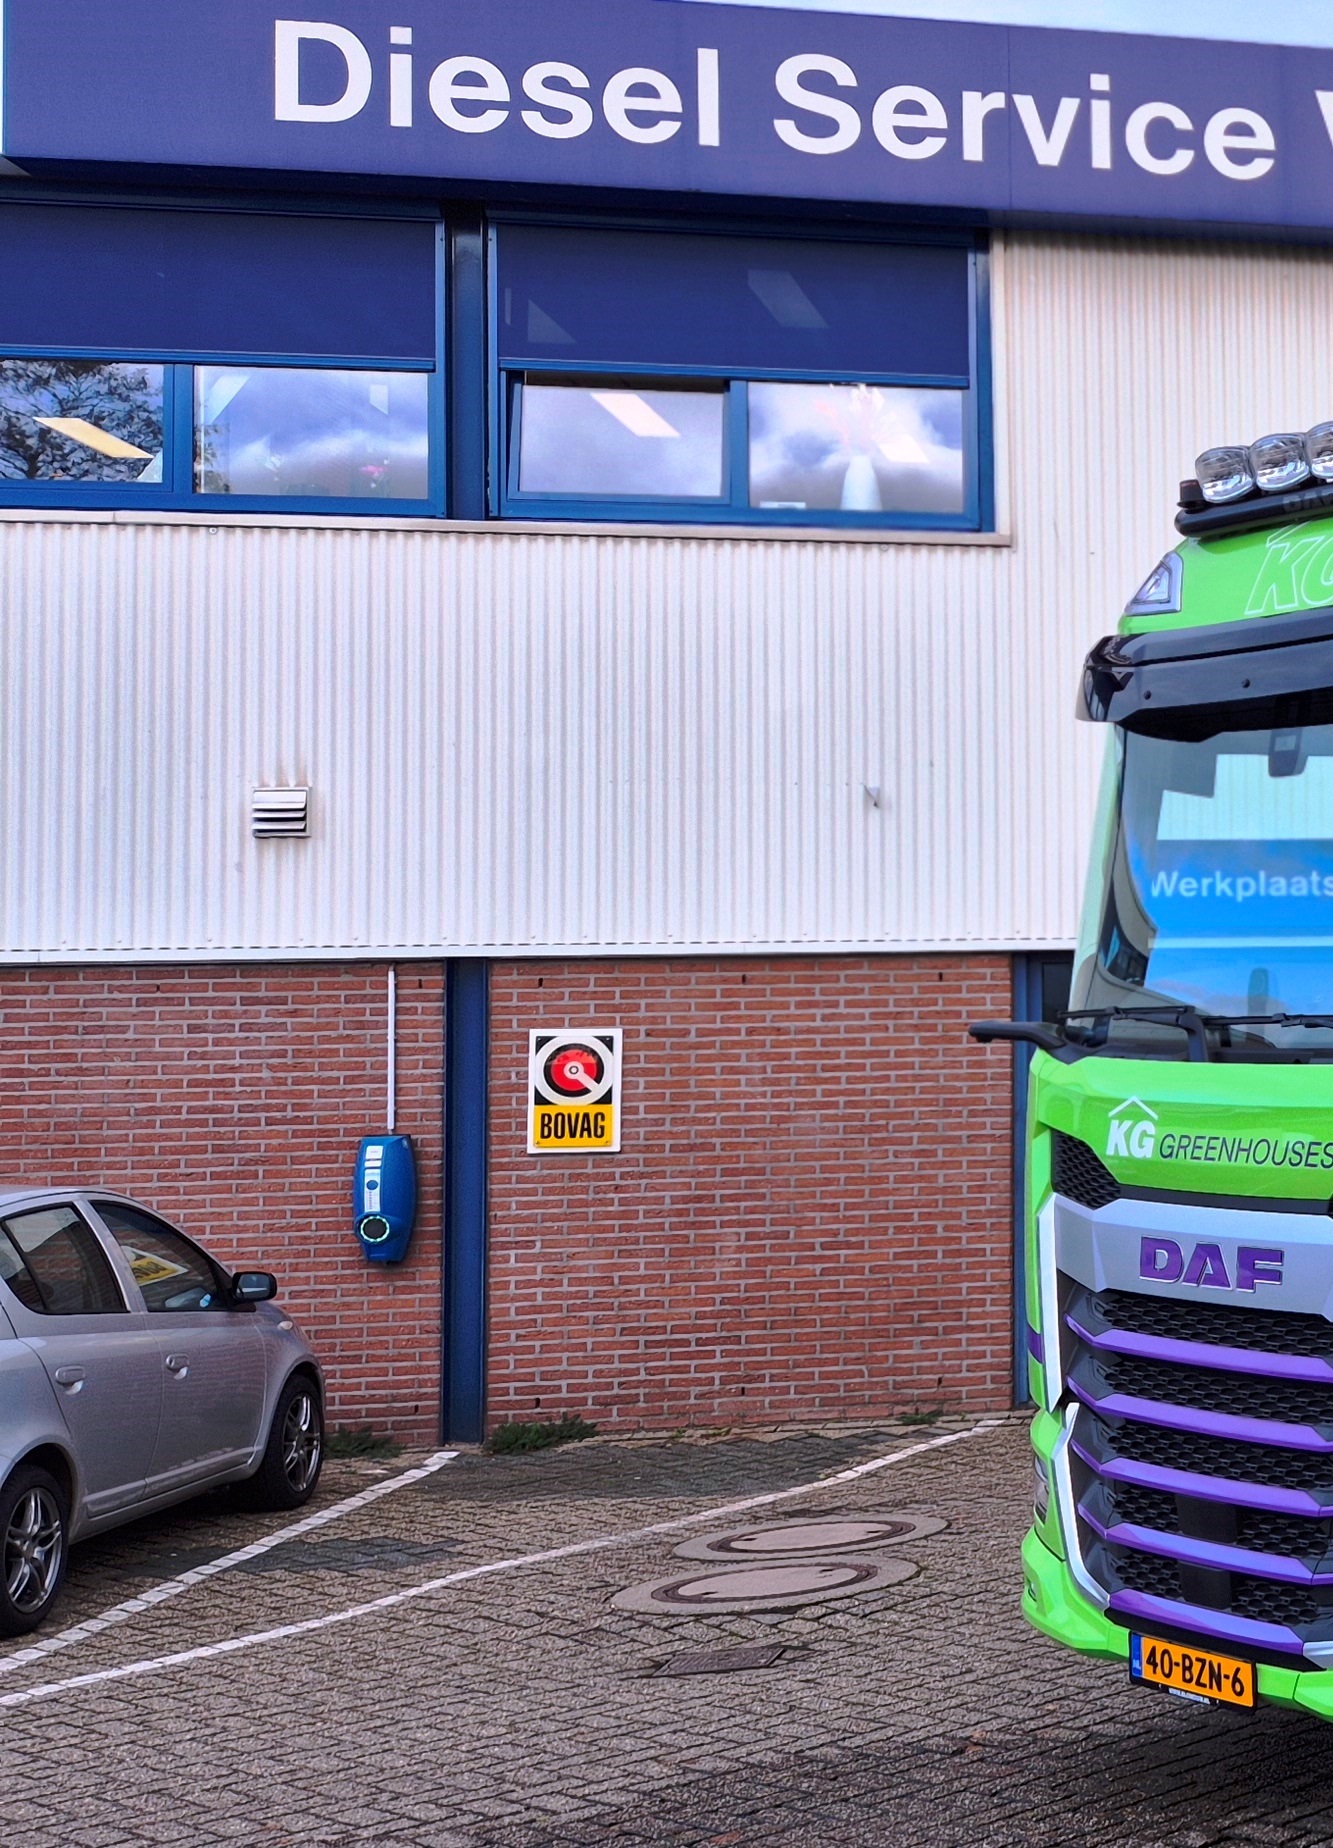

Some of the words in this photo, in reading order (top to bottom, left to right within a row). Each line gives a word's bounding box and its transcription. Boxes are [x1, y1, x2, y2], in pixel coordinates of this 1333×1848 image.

[274, 19, 720, 147] Diesel
[773, 53, 1276, 181] Service
[539, 1111, 606, 1140] BOVAG
[1106, 1119, 1156, 1159] KG
[1139, 1236, 1285, 1295] DAF
[1145, 1644, 1246, 1698] 40-BZN-6
